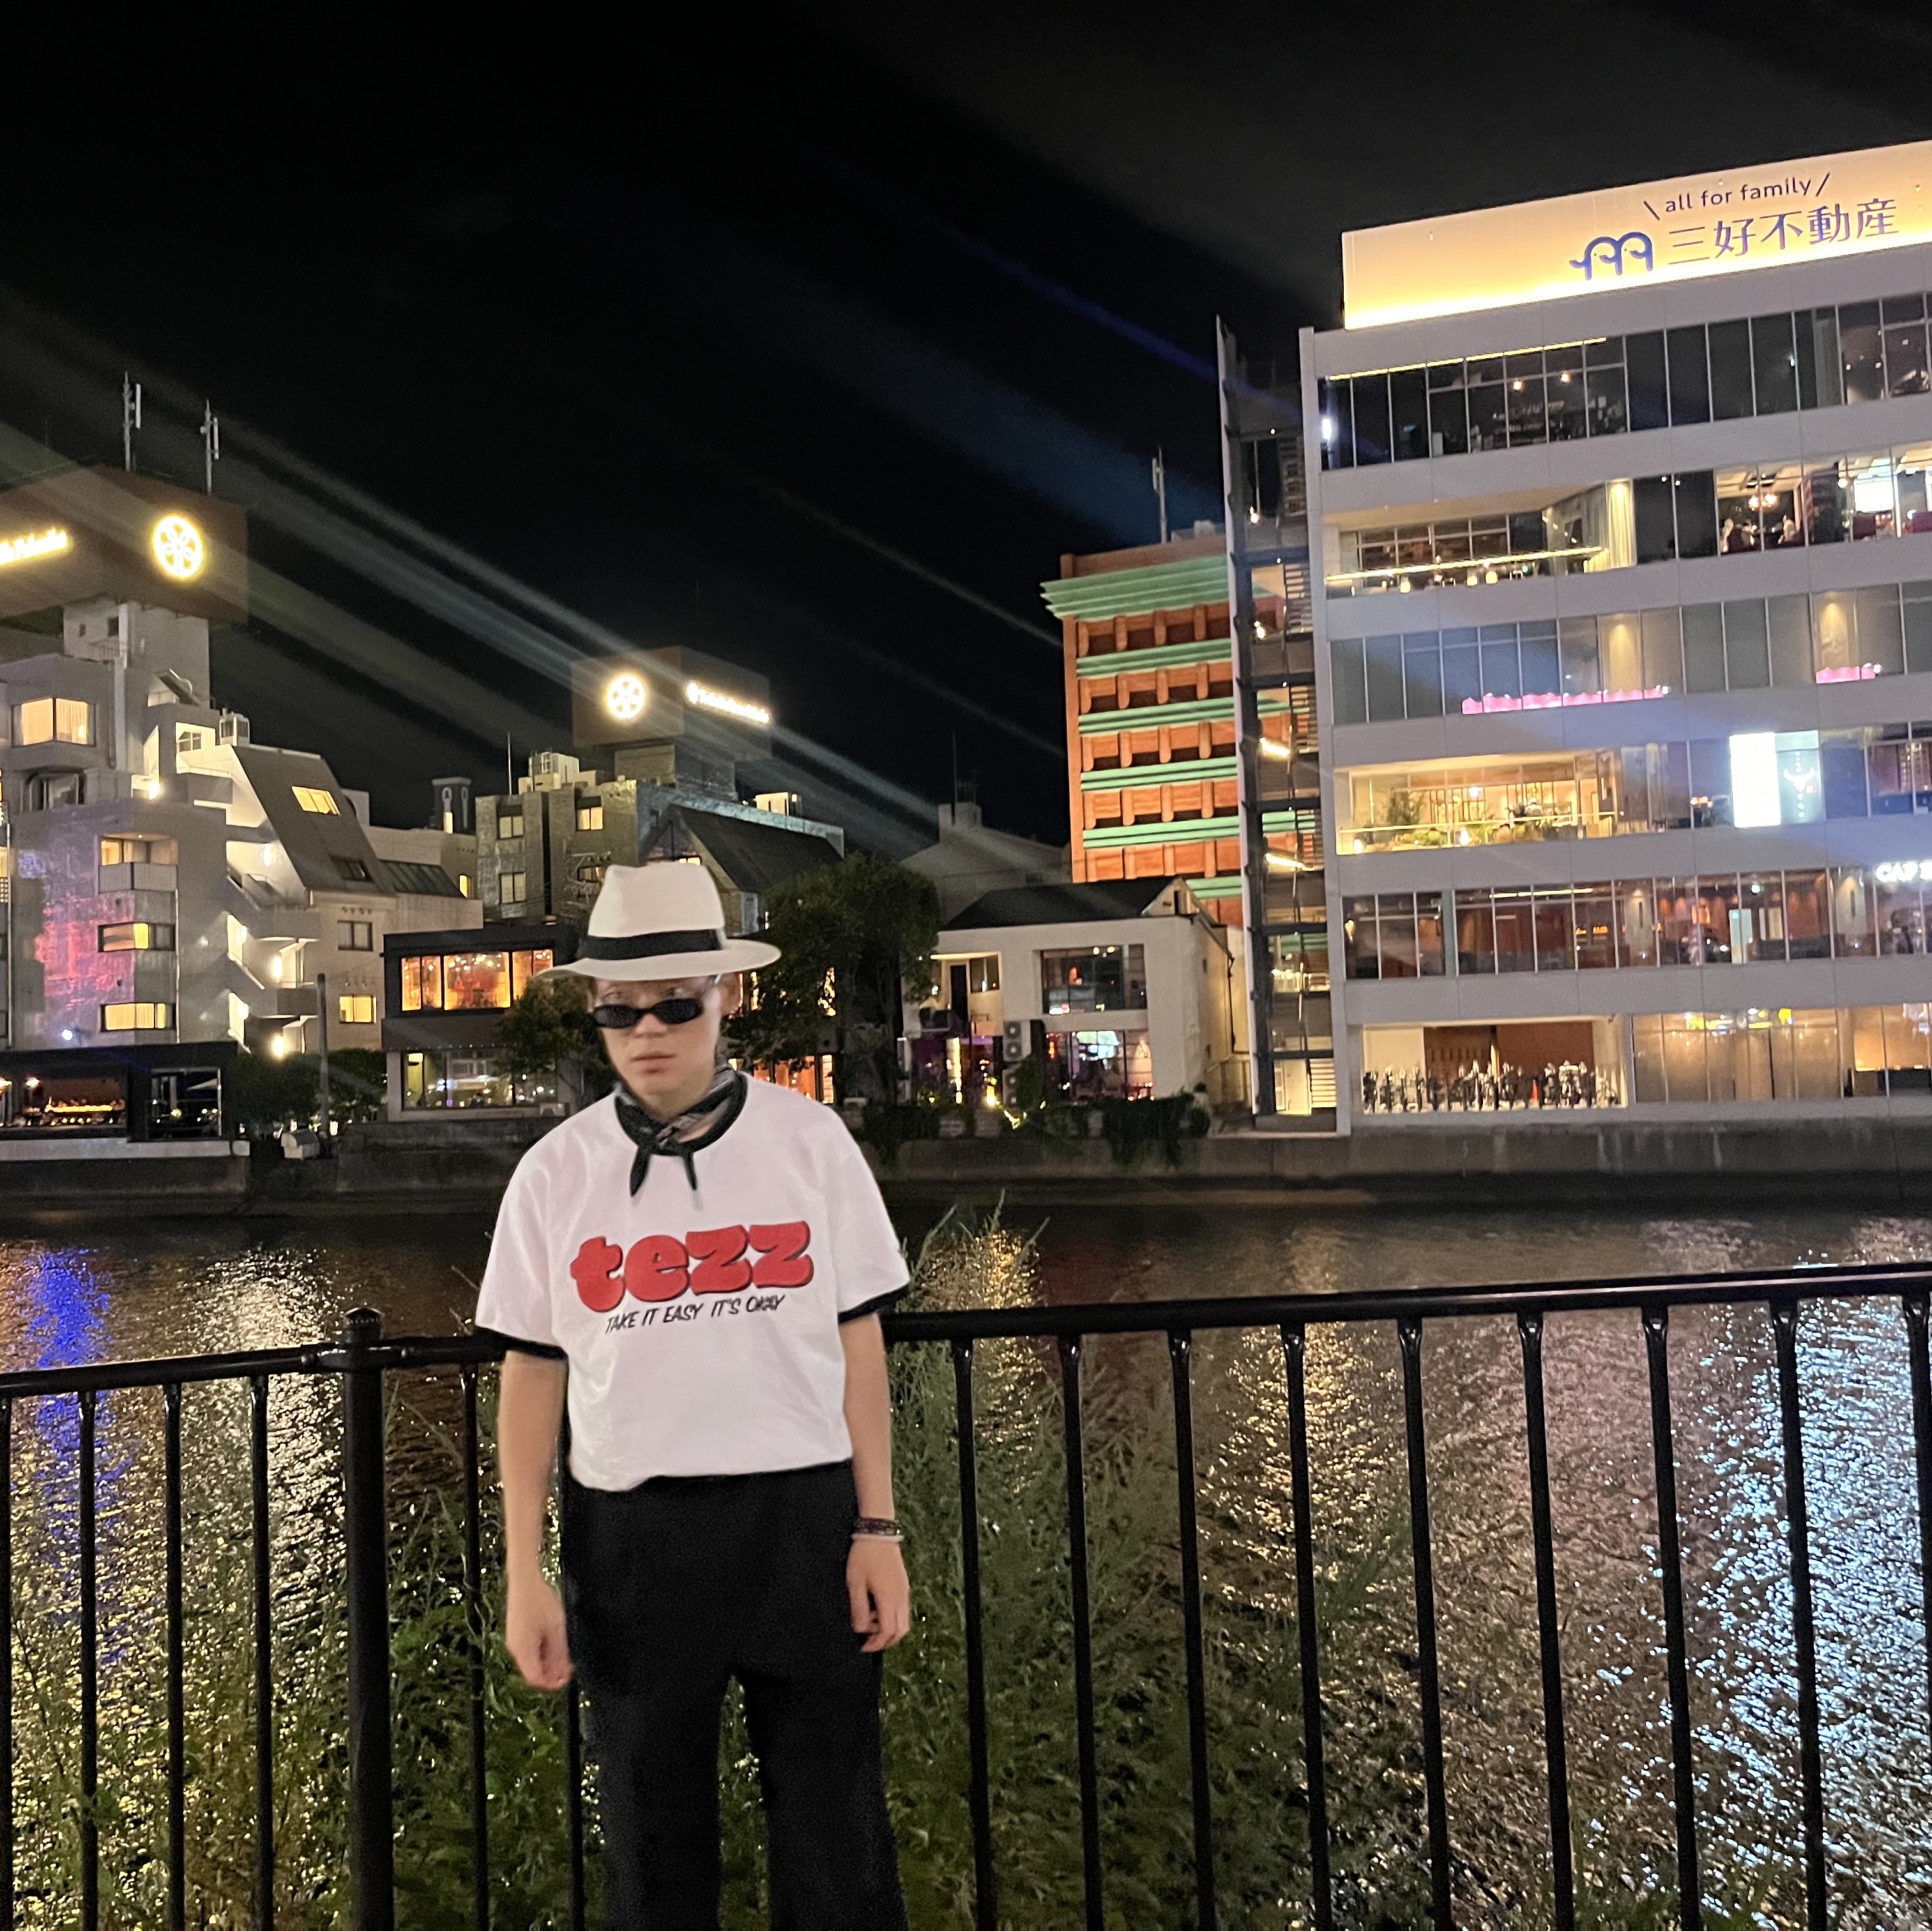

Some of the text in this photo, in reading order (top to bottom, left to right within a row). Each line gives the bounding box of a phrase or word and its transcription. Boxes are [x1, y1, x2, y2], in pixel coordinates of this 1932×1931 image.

[1666, 178, 1811, 213] all for family
[1668, 198, 1899, 265] 三好不動産
[570, 1220, 814, 1313] tezz
[605, 1311, 639, 1334] TAKE
[642, 1308, 658, 1326] IT
[663, 1303, 704, 1323] EASY
[710, 1298, 742, 1317] IT'S
